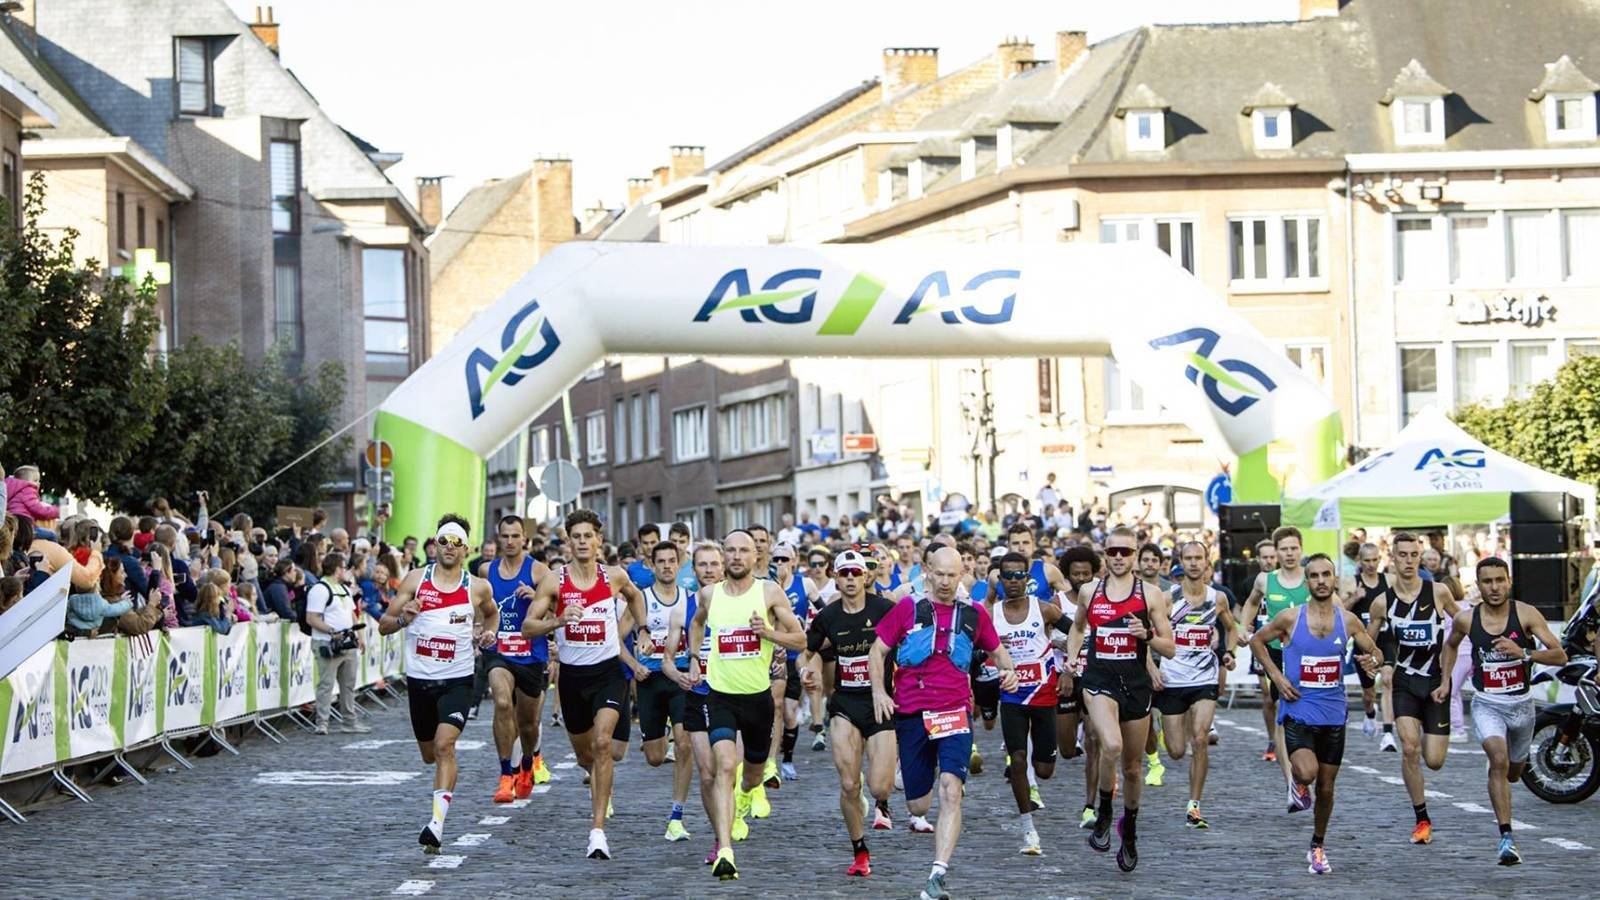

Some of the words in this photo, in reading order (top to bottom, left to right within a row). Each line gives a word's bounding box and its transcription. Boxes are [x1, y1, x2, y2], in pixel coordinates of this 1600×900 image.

[693, 268, 822, 323] AG
[893, 270, 1020, 324] AG
[465, 299, 561, 420] AG
[1148, 327, 1277, 417] AG
[1414, 448, 1486, 470] AG
[1432, 481, 1483, 490] YEARS
[570, 624, 601, 634] SCHYNS
[583, 633, 588, 642] 1
[720, 635, 750, 643] CASTEELE
[1103, 637, 1128, 646] ADAM
[417, 640, 455, 652] HAEGEMAN
[736, 643, 744, 652] 11
[1112, 645, 1119, 654] 7
[853, 673, 864, 681] 20
[1317, 674, 1327, 682] 13
[1490, 669, 1517, 680] RAZYN
